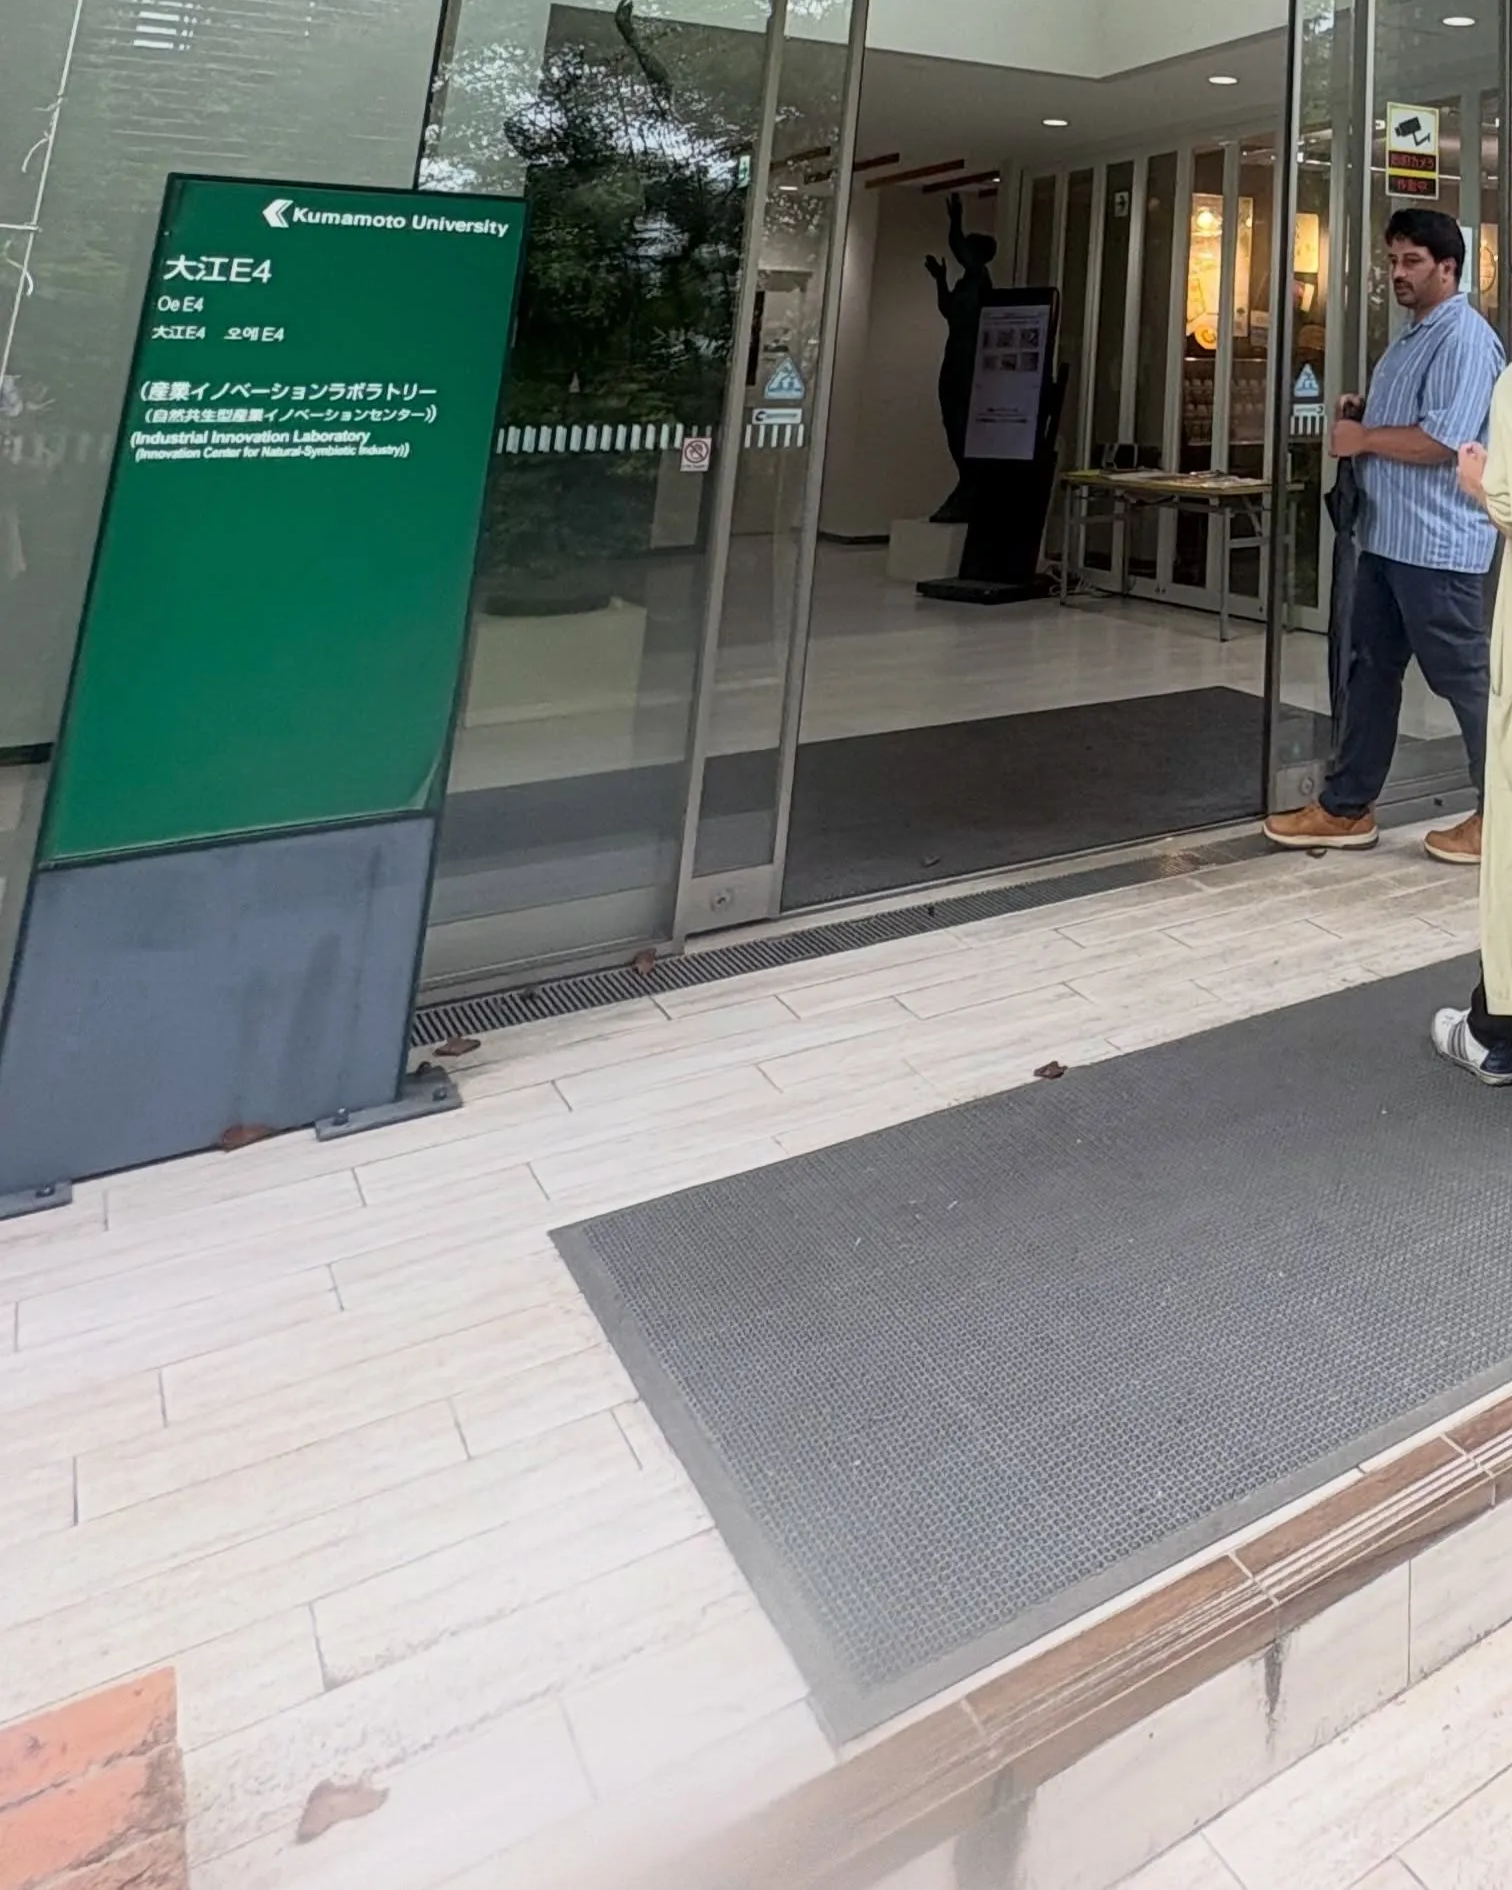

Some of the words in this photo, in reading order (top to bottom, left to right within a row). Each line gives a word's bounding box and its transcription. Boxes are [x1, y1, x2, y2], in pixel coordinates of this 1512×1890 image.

[293, 207, 406, 229] Kumamoto
[412, 215, 509, 237] University
[163, 254, 272, 283] 大江E4
[157, 295, 180, 312] Oe
[182, 296, 204, 312] E4
[261, 327, 285, 342] E4
[141, 381, 437, 401] (産業イノベーションラボラトリー
[130, 430, 209, 448] (Industrial
[211, 430, 290, 444] Innovation
[293, 430, 371, 446] Laboratory
[203, 446, 241, 458] Center
[243, 445, 261, 458] for
